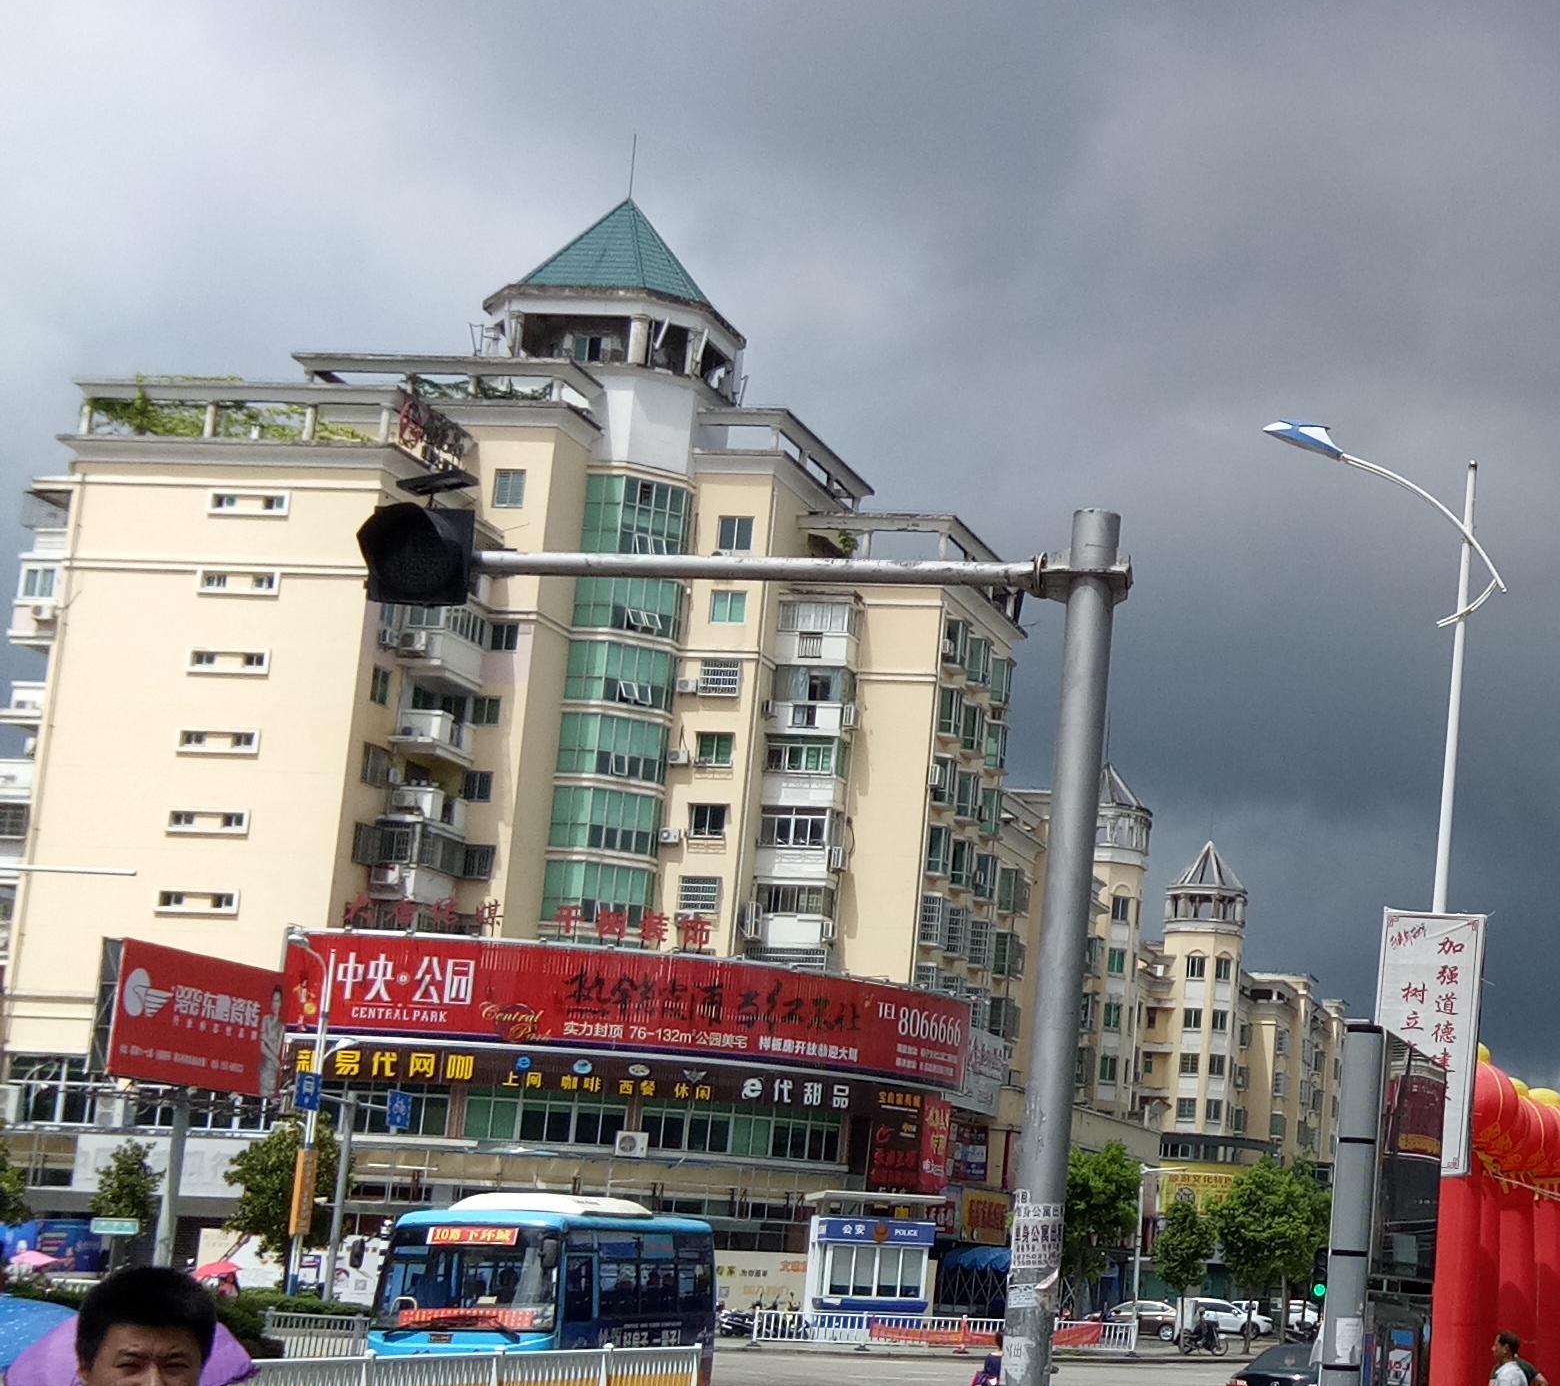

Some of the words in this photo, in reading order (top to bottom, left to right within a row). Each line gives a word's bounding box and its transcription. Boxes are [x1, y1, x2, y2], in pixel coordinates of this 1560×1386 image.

[336, 952, 476, 1005] 中央公园
[351, 1006, 411, 1021] CENTRAL
[412, 1008, 448, 1023] PARK
[478, 1001, 544, 1024] Central
[877, 1001, 897, 1020] TEL
[898, 1006, 962, 1047] 8066666
[1400, 981, 1428, 1050] 树立
[1430, 937, 1465, 1101] 加强道德建
[842, 1224, 866, 1235] 公安
[894, 1228, 918, 1237] POLICE
